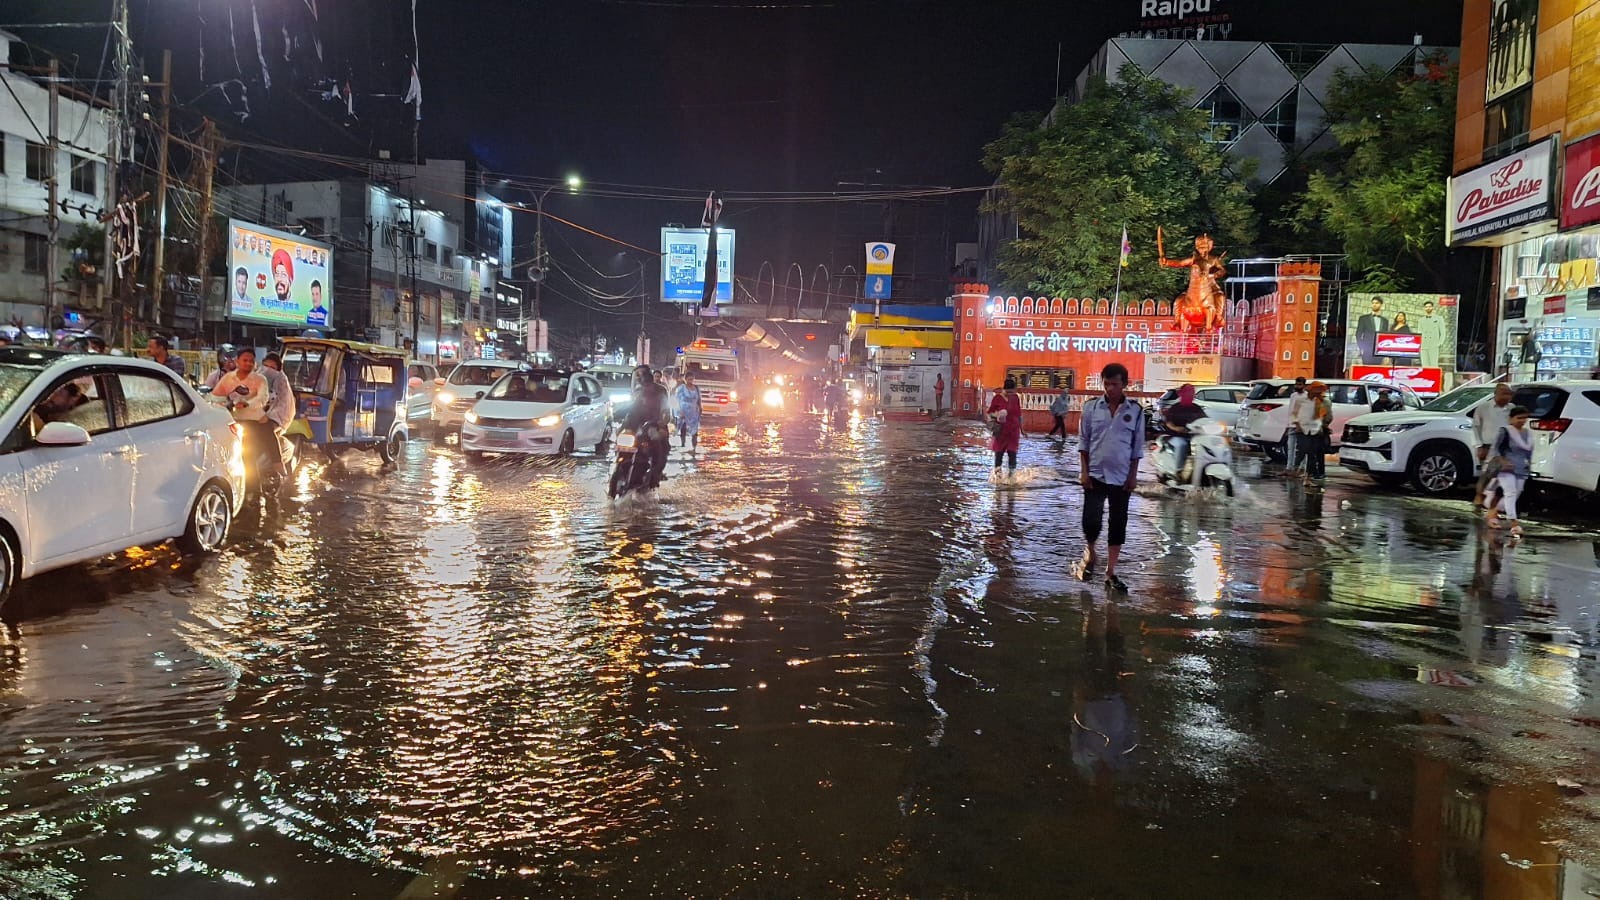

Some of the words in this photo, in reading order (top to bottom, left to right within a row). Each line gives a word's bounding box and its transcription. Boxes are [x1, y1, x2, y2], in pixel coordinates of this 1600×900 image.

[1490, 159, 1523, 187] KP
[1457, 179, 1543, 223] Paradise
[1529, 206, 1548, 220] GROUP
[1009, 331, 1045, 351] शहीद
[1048, 331, 1070, 351] वीर
[1071, 336, 1122, 352] नारायण
